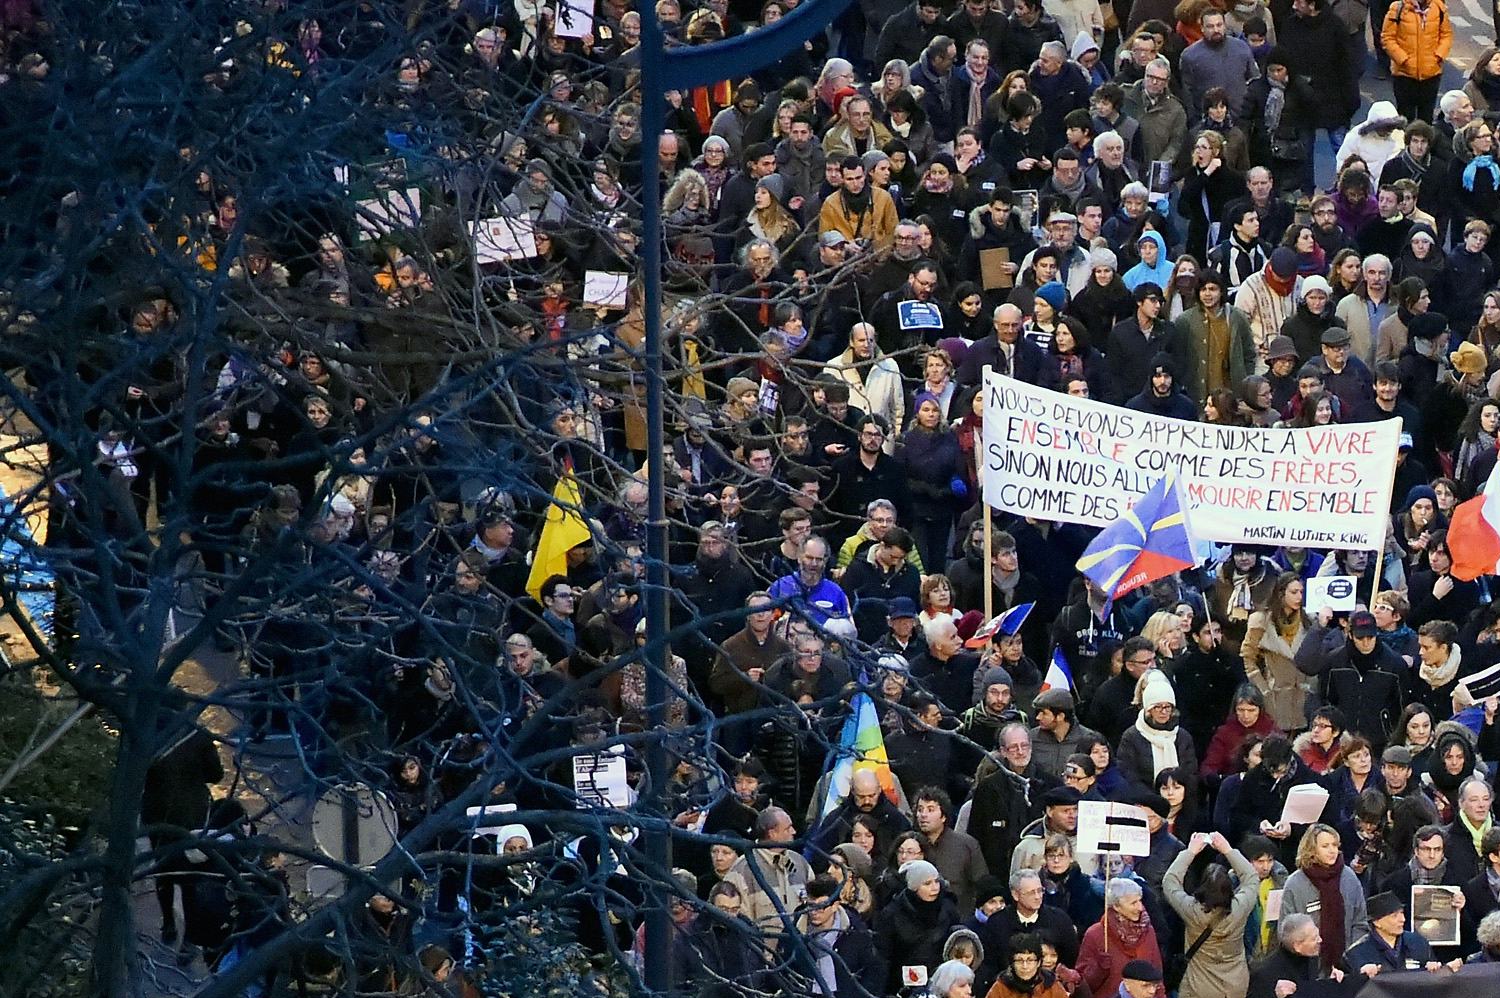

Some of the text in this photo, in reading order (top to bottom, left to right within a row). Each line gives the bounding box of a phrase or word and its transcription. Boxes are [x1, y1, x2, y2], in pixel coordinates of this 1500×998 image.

[1006, 416, 1128, 464] ENSEMBLE
[1135, 449, 1213, 478] COMME
[1219, 457, 1265, 479] DES
[1053, 403, 1135, 439] DEVONS
[1138, 421, 1275, 455] APPRENDRE
[1000, 483, 1077, 516] COMME
[1080, 493, 1120, 521] DES
[1056, 459, 1108, 488] NOUS
[1265, 489, 1378, 514] ENSEMBLE
[1290, 528, 1336, 542] LUTHER
